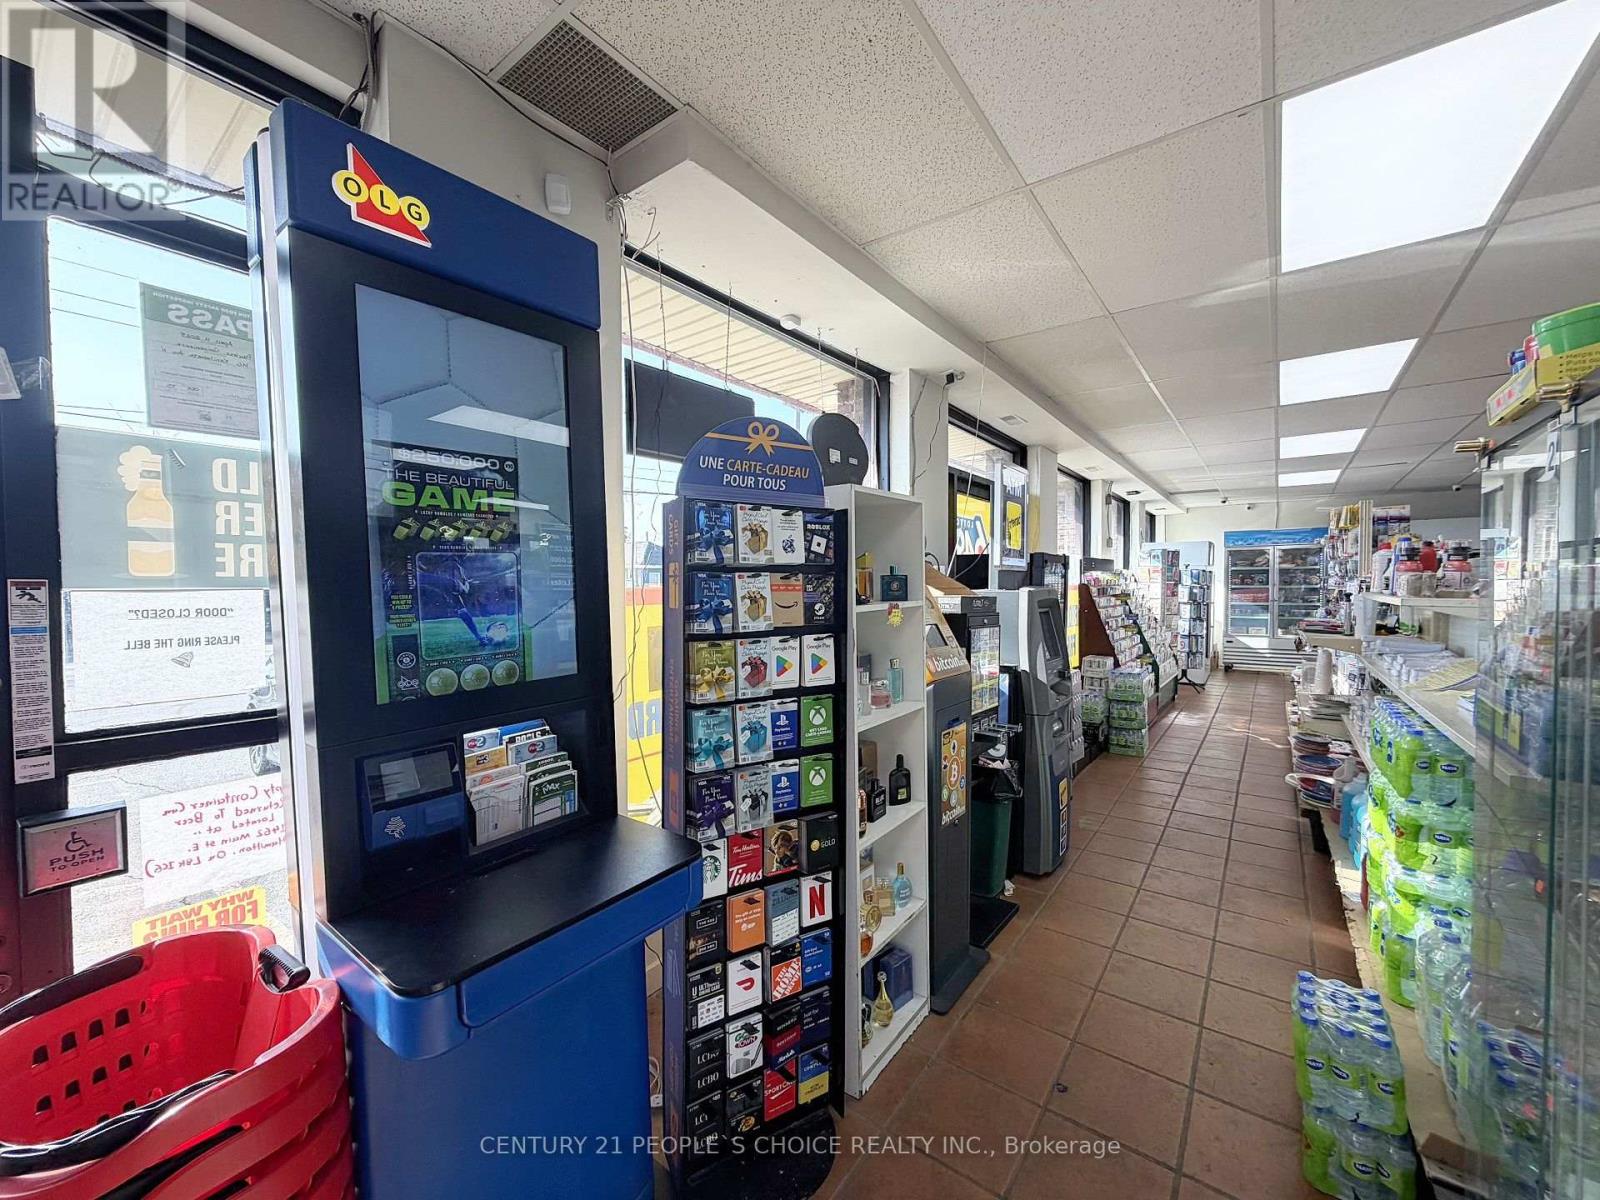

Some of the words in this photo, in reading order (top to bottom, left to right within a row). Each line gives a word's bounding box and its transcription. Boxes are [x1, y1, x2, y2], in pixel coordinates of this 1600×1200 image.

[343, 176, 422, 221] OLG
[383, 467, 421, 482] THE
[425, 472, 515, 490] BEAUTIFUL
[699, 455, 724, 470] UNE
[726, 459, 810, 479] CARTE-CADEAU
[723, 474, 755, 489] POUR
[758, 477, 787, 491] TOUS
[382, 481, 516, 513] GAME
[933, 653, 960, 672] bitcoin
[49, 847, 104, 867] PUSH
[51, 864, 66, 872] TO
[71, 855, 105, 867] OPEN
[728, 863, 763, 888] Tims
[809, 884, 825, 919] N
[697, 1071, 719, 1089] LCBO
